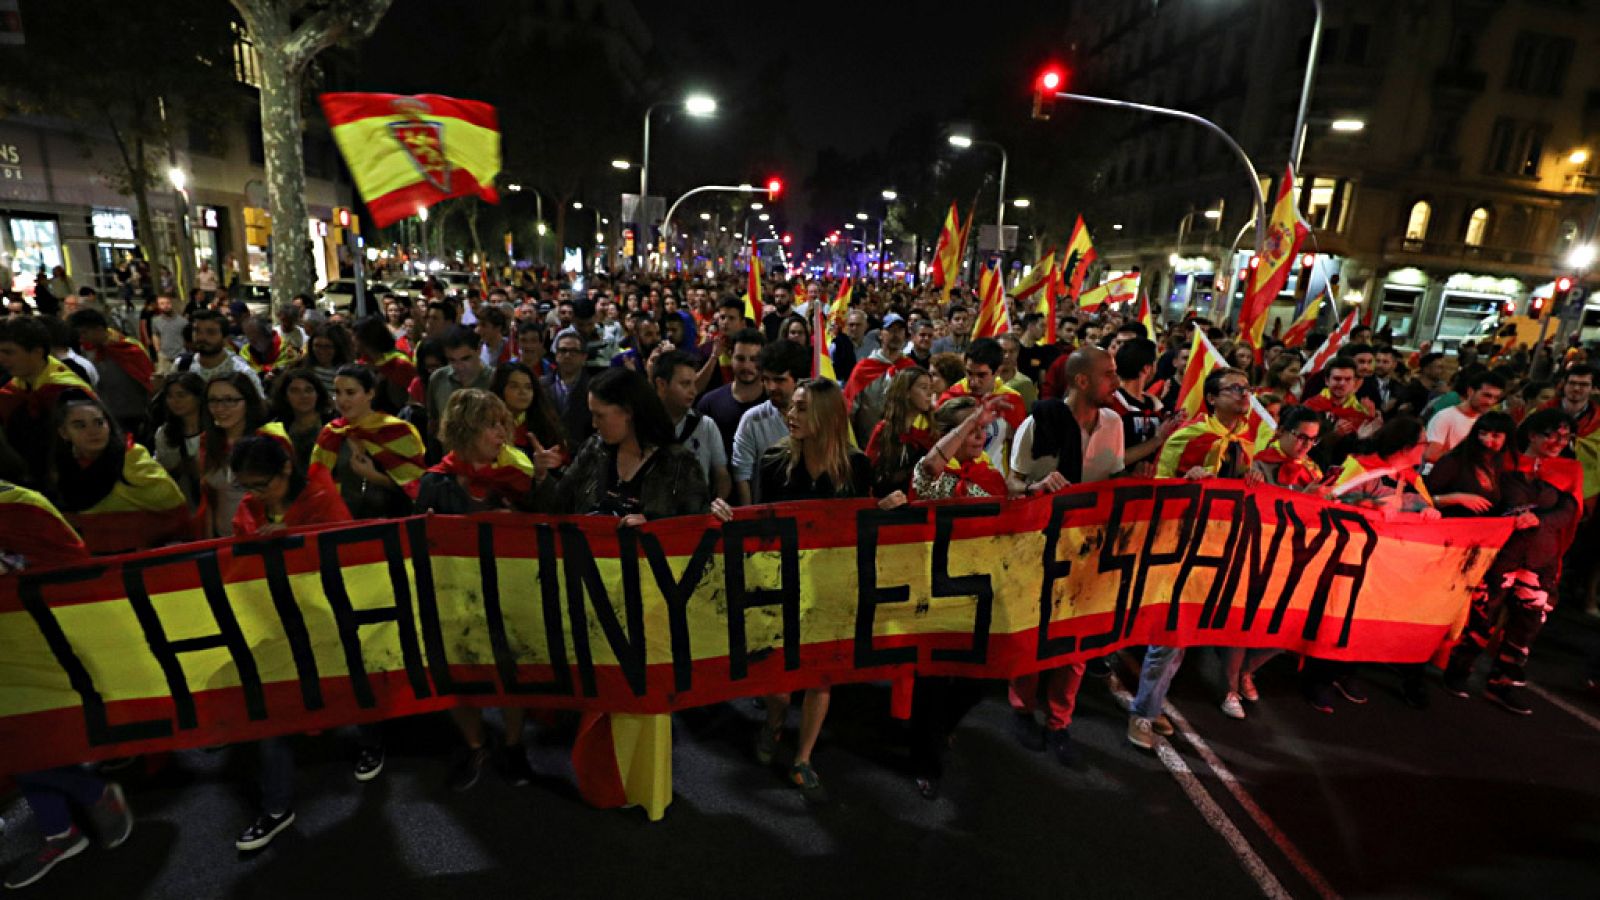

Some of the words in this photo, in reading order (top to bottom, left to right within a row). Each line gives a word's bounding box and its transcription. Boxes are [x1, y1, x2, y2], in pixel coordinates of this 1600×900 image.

[17, 516, 800, 747] CATALUNYA
[854, 504, 993, 669] ES
[1037, 483, 1378, 661] ESPANYA
